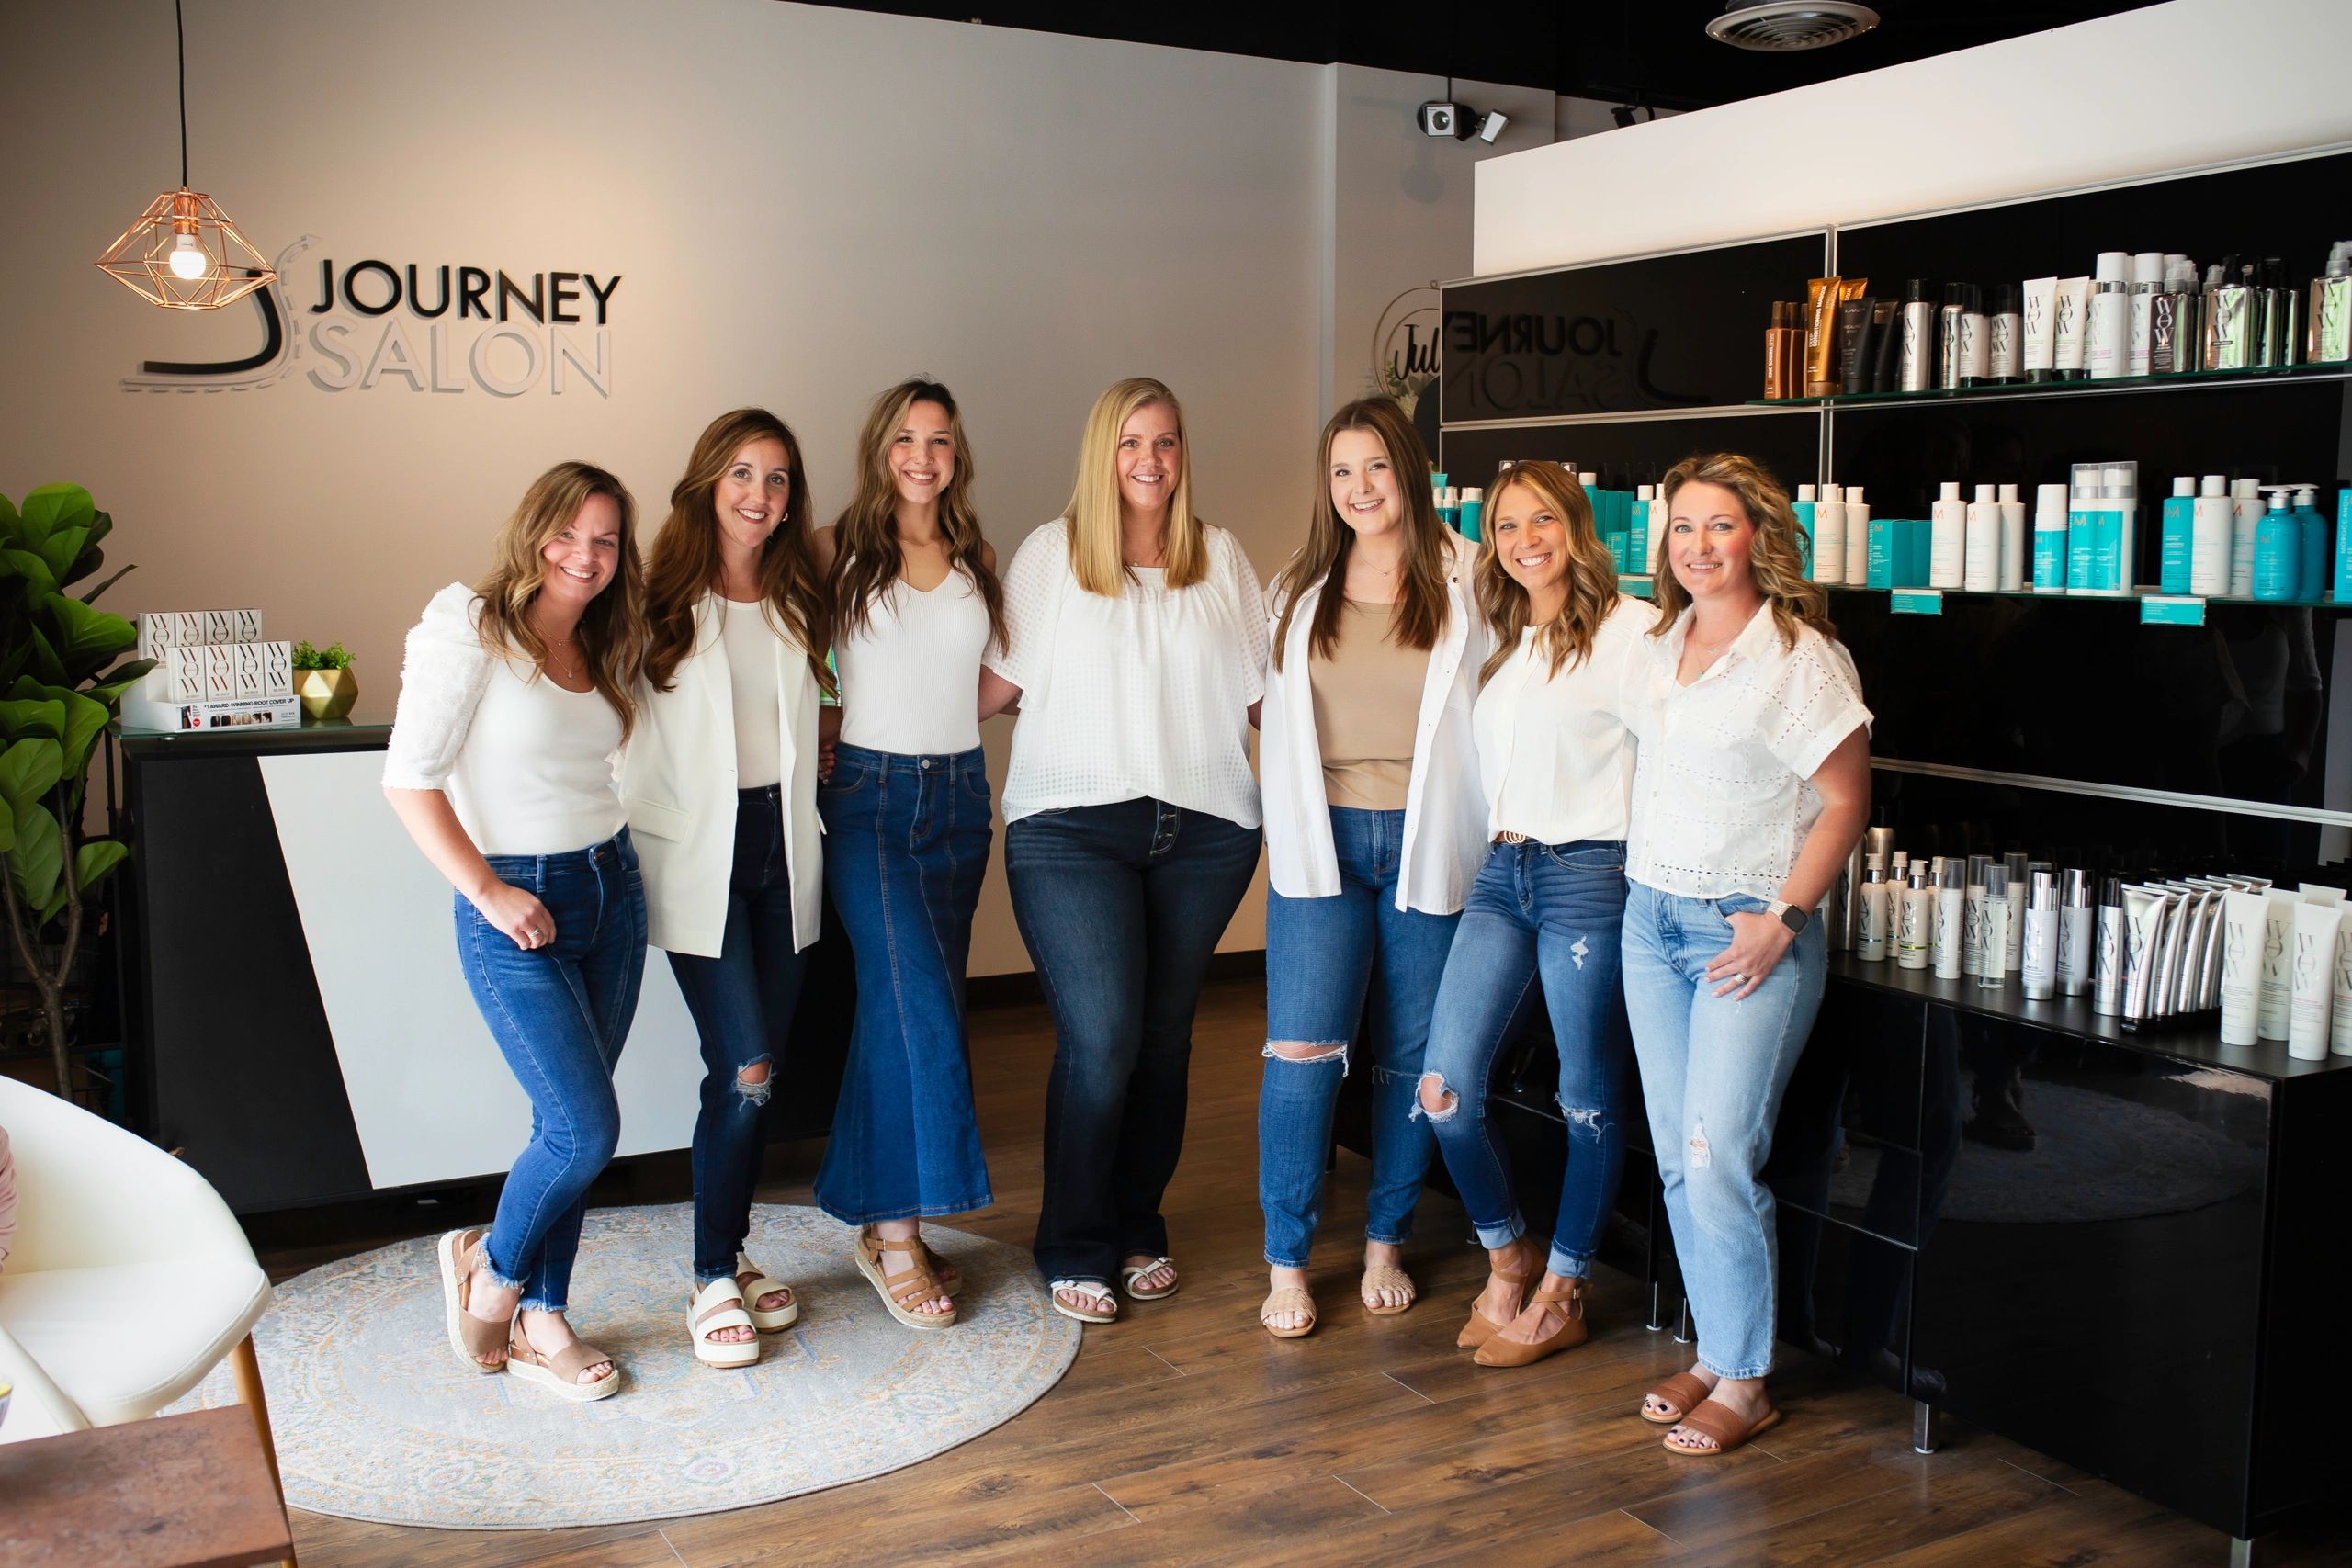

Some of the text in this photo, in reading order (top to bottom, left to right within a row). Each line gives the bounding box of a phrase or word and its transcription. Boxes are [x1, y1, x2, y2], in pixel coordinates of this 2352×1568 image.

[311, 258, 622, 325] JOURNEY
[1812, 285, 1827, 347] CONDITIONING MASQUE
[2154, 299, 2177, 344] WOW
[307, 316, 612, 399] SALON
[1816, 508, 1828, 519] M
[2073, 514, 2086, 526] M
[2340, 495, 2349, 554] MOROCCANOIL
[179, 648, 201, 694] WOW
[209, 646, 232, 692] WOW
[238, 644, 263, 690] WOW
[267, 642, 291, 688] WOW
